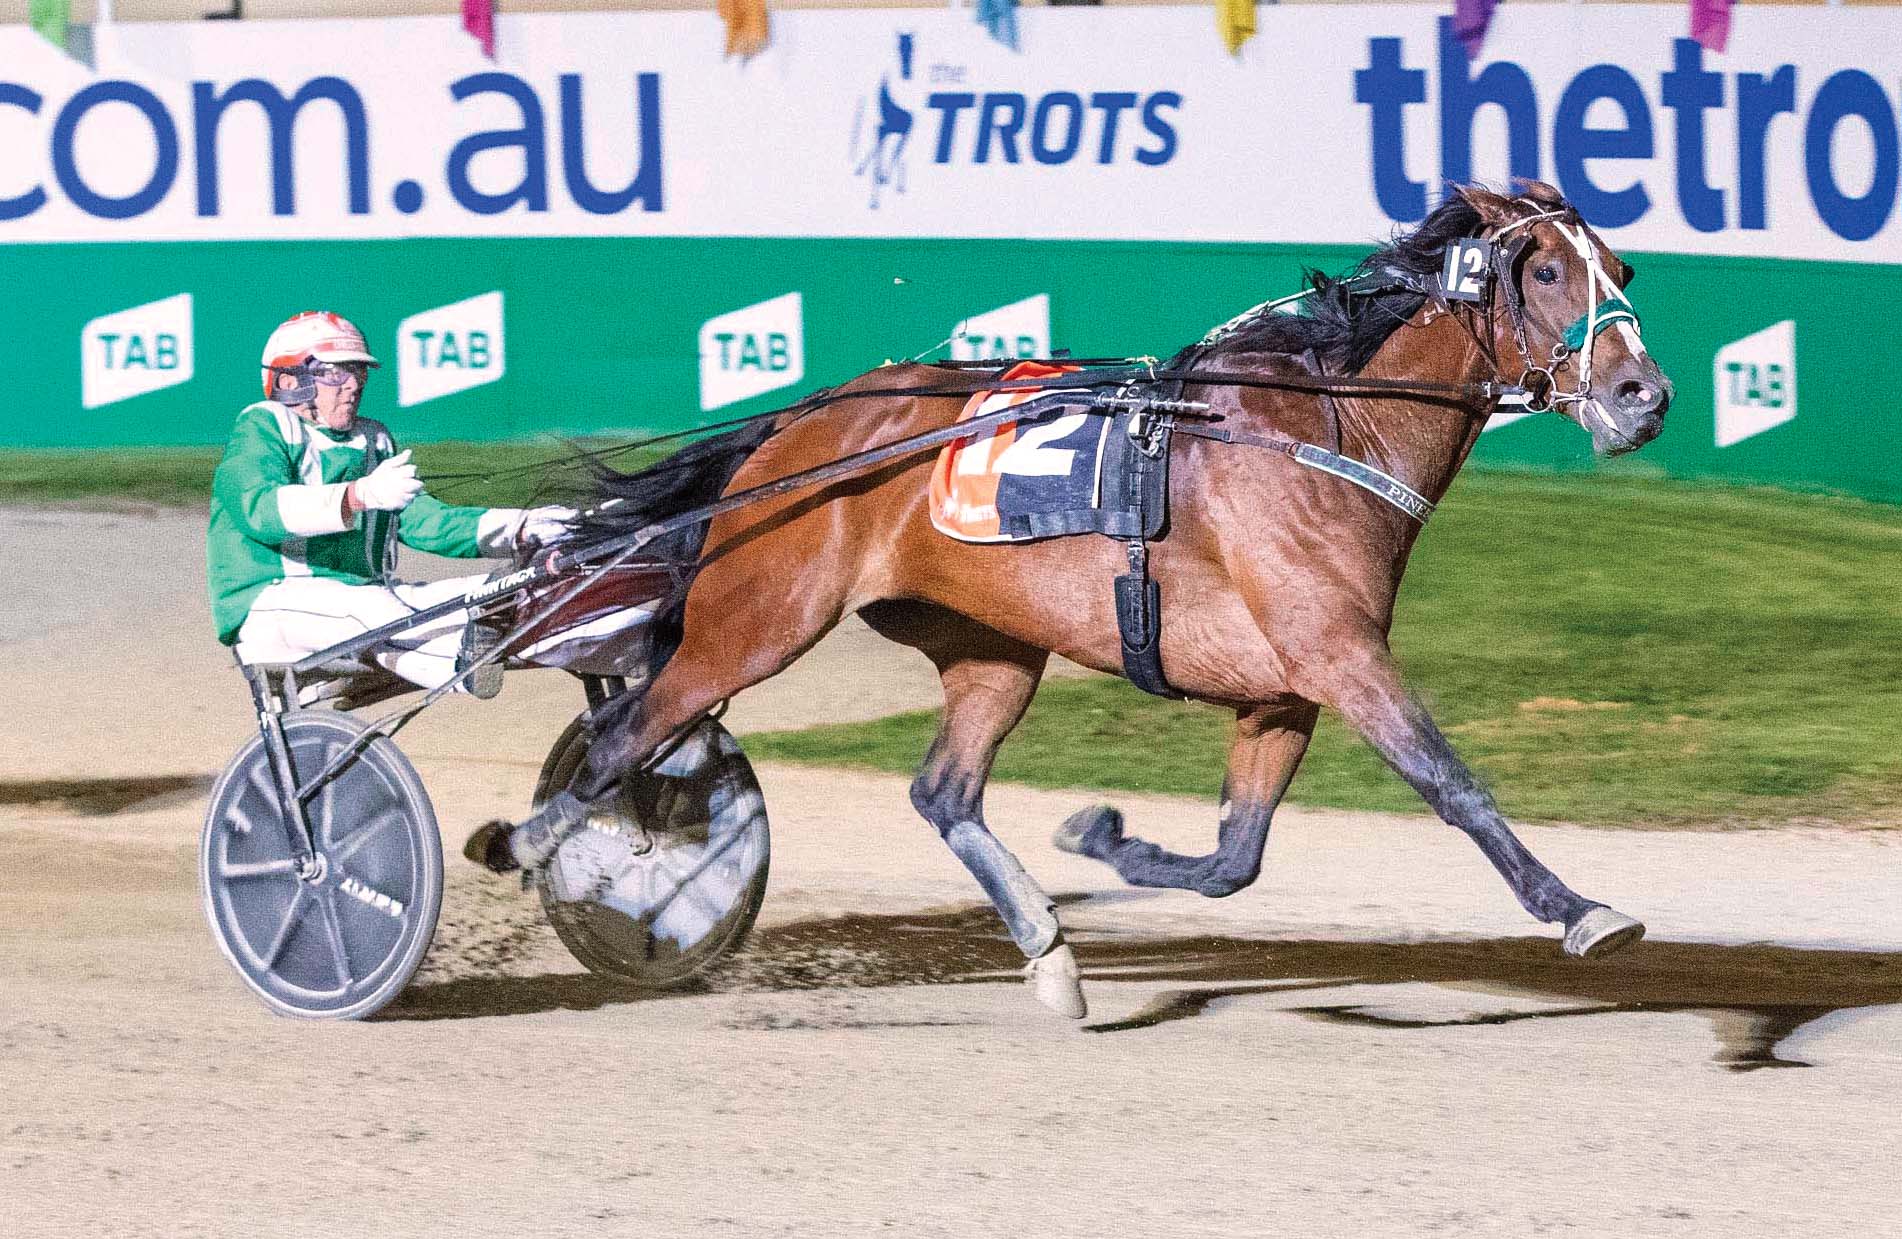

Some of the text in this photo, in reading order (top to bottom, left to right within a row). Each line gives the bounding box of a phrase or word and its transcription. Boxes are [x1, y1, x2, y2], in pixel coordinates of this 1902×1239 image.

[928, 92, 1183, 166] TROTS
[1354, 15, 1900, 242] thetro
[1446, 245, 1483, 294] 12
[98, 333, 180, 370] TAB
[411, 330, 490, 369] TAB
[713, 332, 790, 372] TAB
[1725, 361, 1783, 408] TAB
[957, 387, 1092, 476] 12
